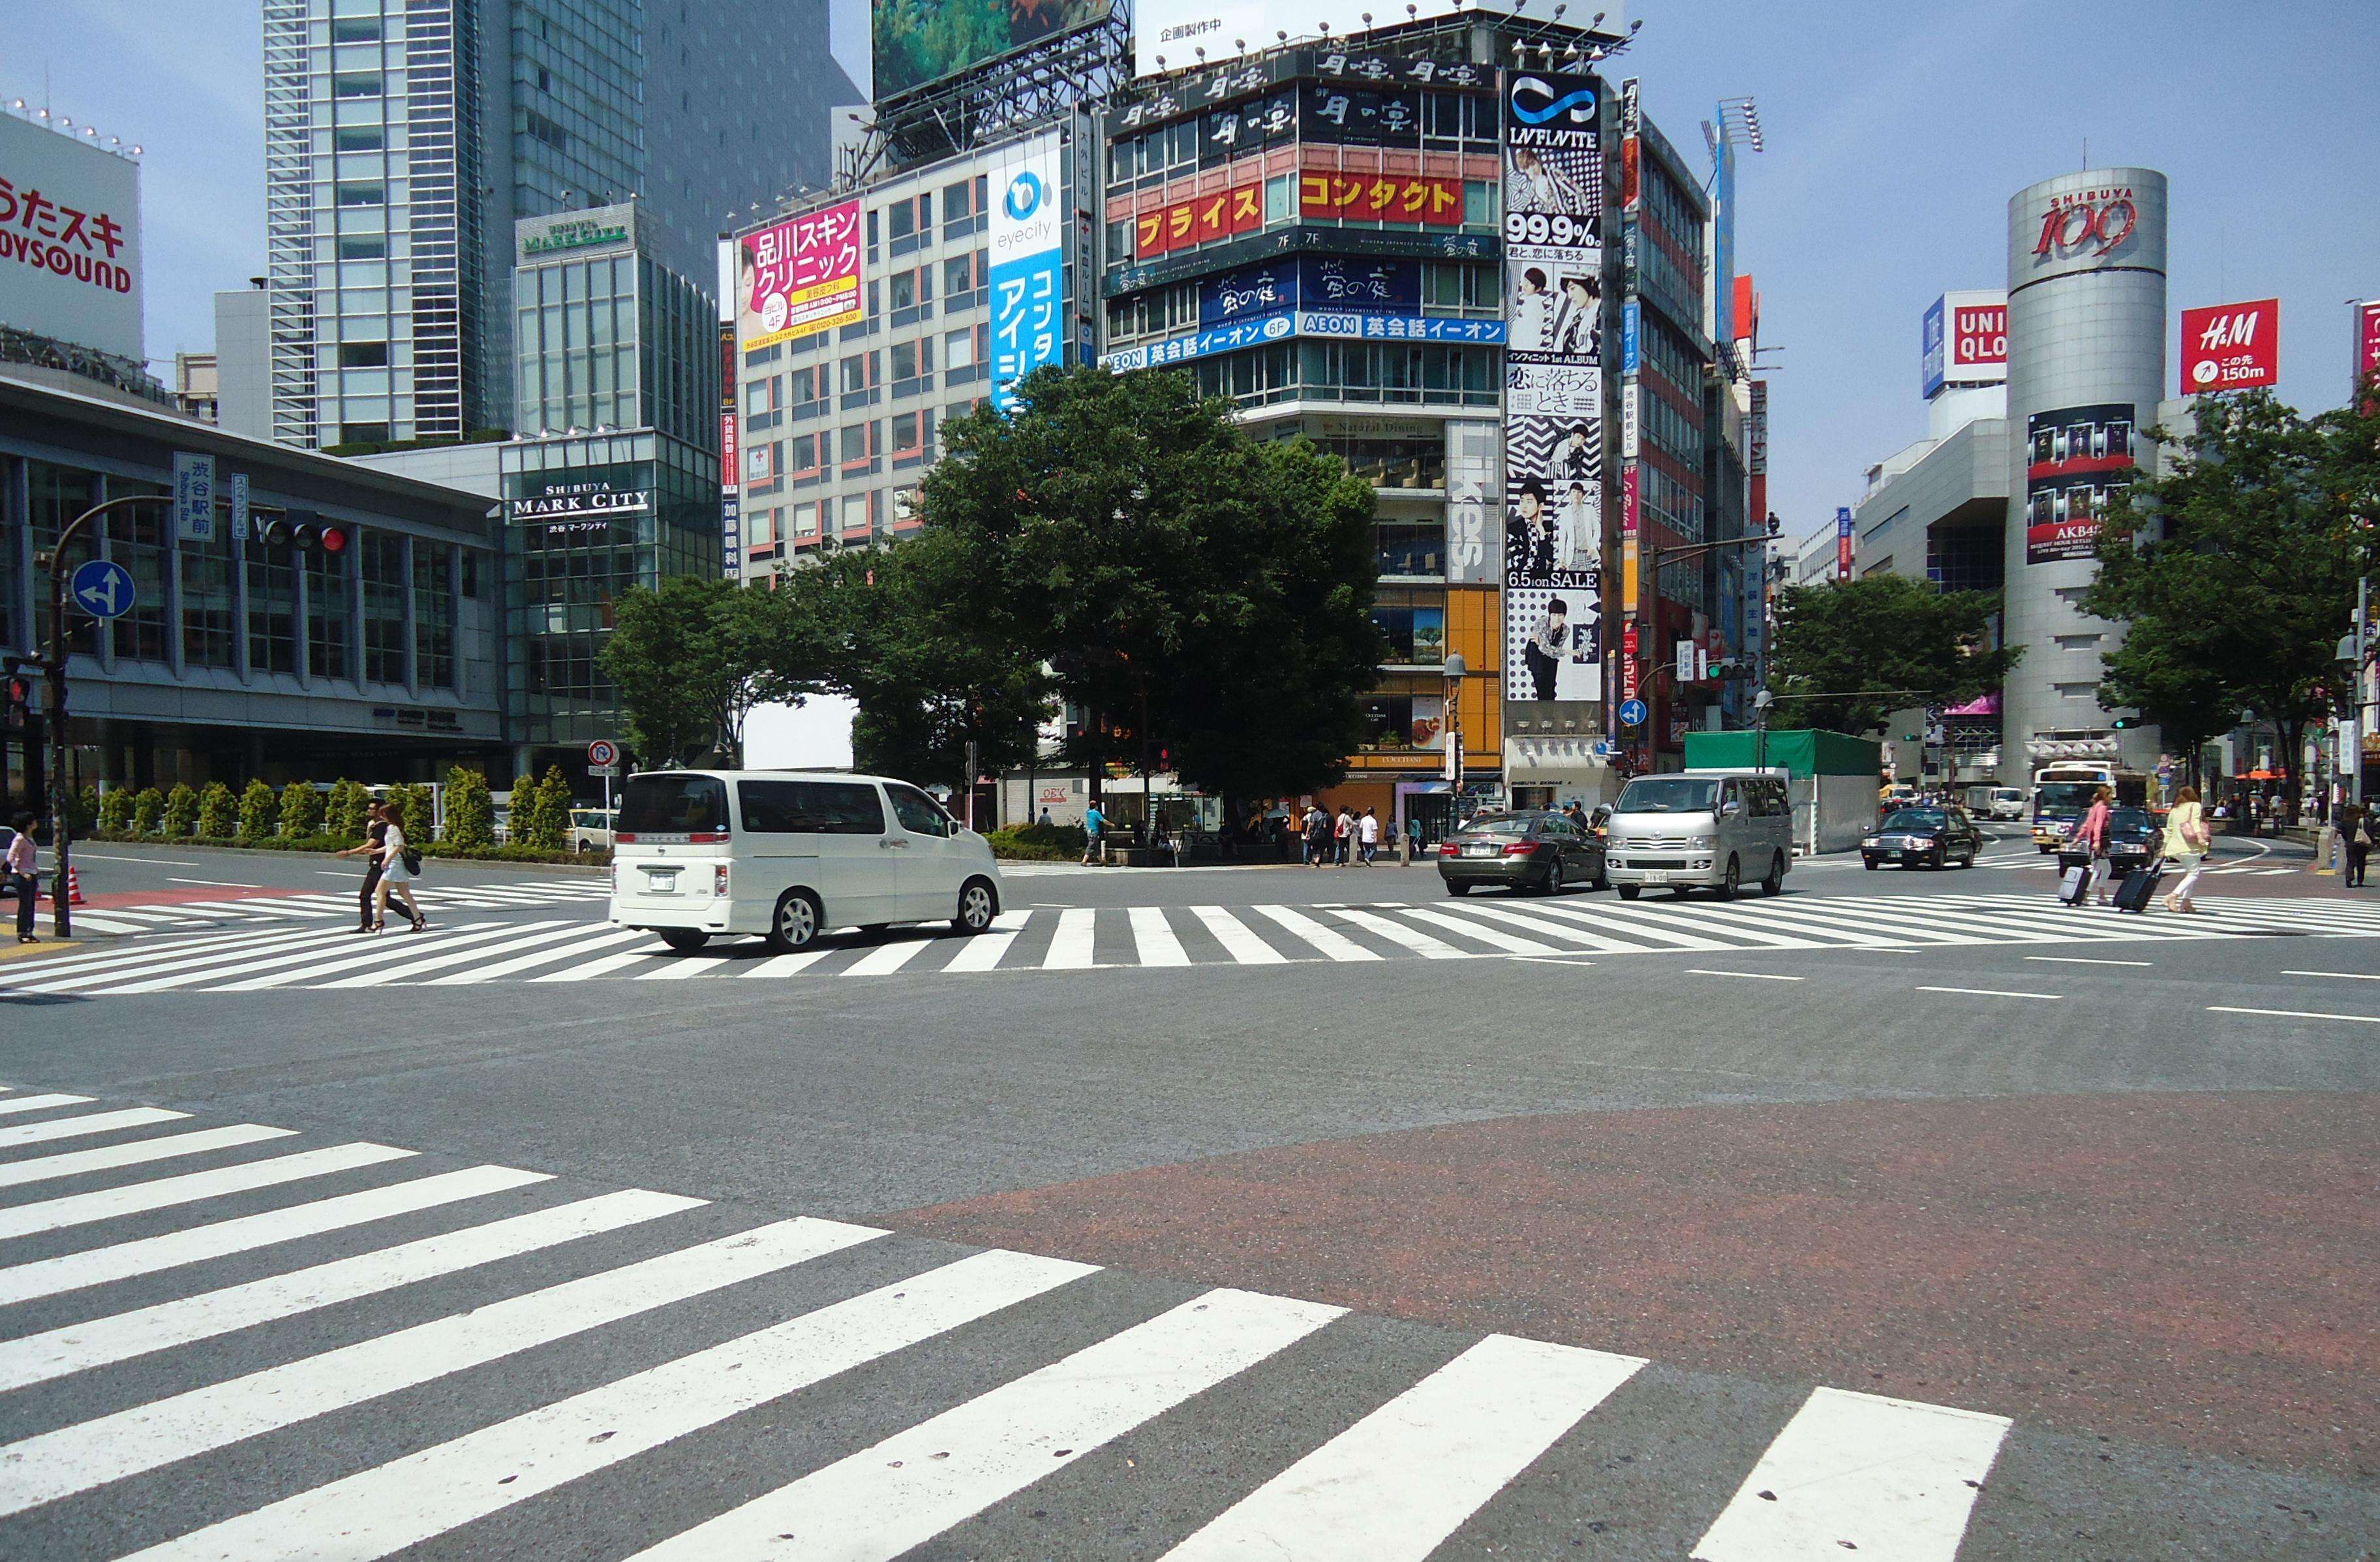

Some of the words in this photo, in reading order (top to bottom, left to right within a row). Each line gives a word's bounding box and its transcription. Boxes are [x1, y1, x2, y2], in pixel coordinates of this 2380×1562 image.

[1161, 18, 1221, 42] 企画製作中
[1510, 127, 1597, 148] INFINITE
[1302, 177, 1456, 213] コンタクト
[2051, 188, 2133, 207] SHIBUYA
[1139, 189, 1259, 247] プライス
[2031, 199, 2136, 257] 109
[757, 211, 857, 268] 品川スキン
[998, 221, 1051, 251] eyecity
[1277, 235, 1290, 248] 7F
[1305, 232, 1319, 244] 7F
[757, 241, 857, 298] クリニック
[768, 315, 782, 328] 4F
[1269, 320, 1285, 333] 6F
[1304, 315, 1356, 333] AEON
[1367, 316, 1501, 339] 英会話イーオン
[1960, 313, 2004, 333] UNI
[2199, 311, 2259, 350] H&M
[1150, 325, 1259, 364] 英会話イーオン
[1960, 335, 2007, 361] QLO
[1104, 349, 1143, 374] AEON
[1508, 352, 1550, 362] インフィニット
[1551, 354, 1563, 363] 1st
[1563, 354, 1598, 365] ALBUM
[2221, 354, 2253, 367] この先
[1508, 366, 1598, 392] 恋に落ちる
[2221, 366, 2265, 381] 150m
[1536, 391, 1569, 414] とき
[1339, 422, 1380, 433] Natural
[1385, 423, 1423, 435] Dining
[1625, 390, 1634, 450] 渋谷駅前ビル
[1623, 466, 1637, 474] 5F
[180, 471, 190, 504] Shibuya
[192, 461, 209, 534] 渋谷駅前
[545, 482, 611, 495] SHIBUYA
[513, 496, 581, 514] MARK
[591, 491, 648, 508] CITY
[549, 525, 566, 533] 渋谷
[568, 521, 607, 532] マークシティ
[724, 504, 737, 565] 加藤眼科
[725, 569, 738, 578] 5F
[1508, 572, 1531, 587] 6.5
[1534, 579, 1550, 587] on
[1550, 572, 1597, 587] SALE
